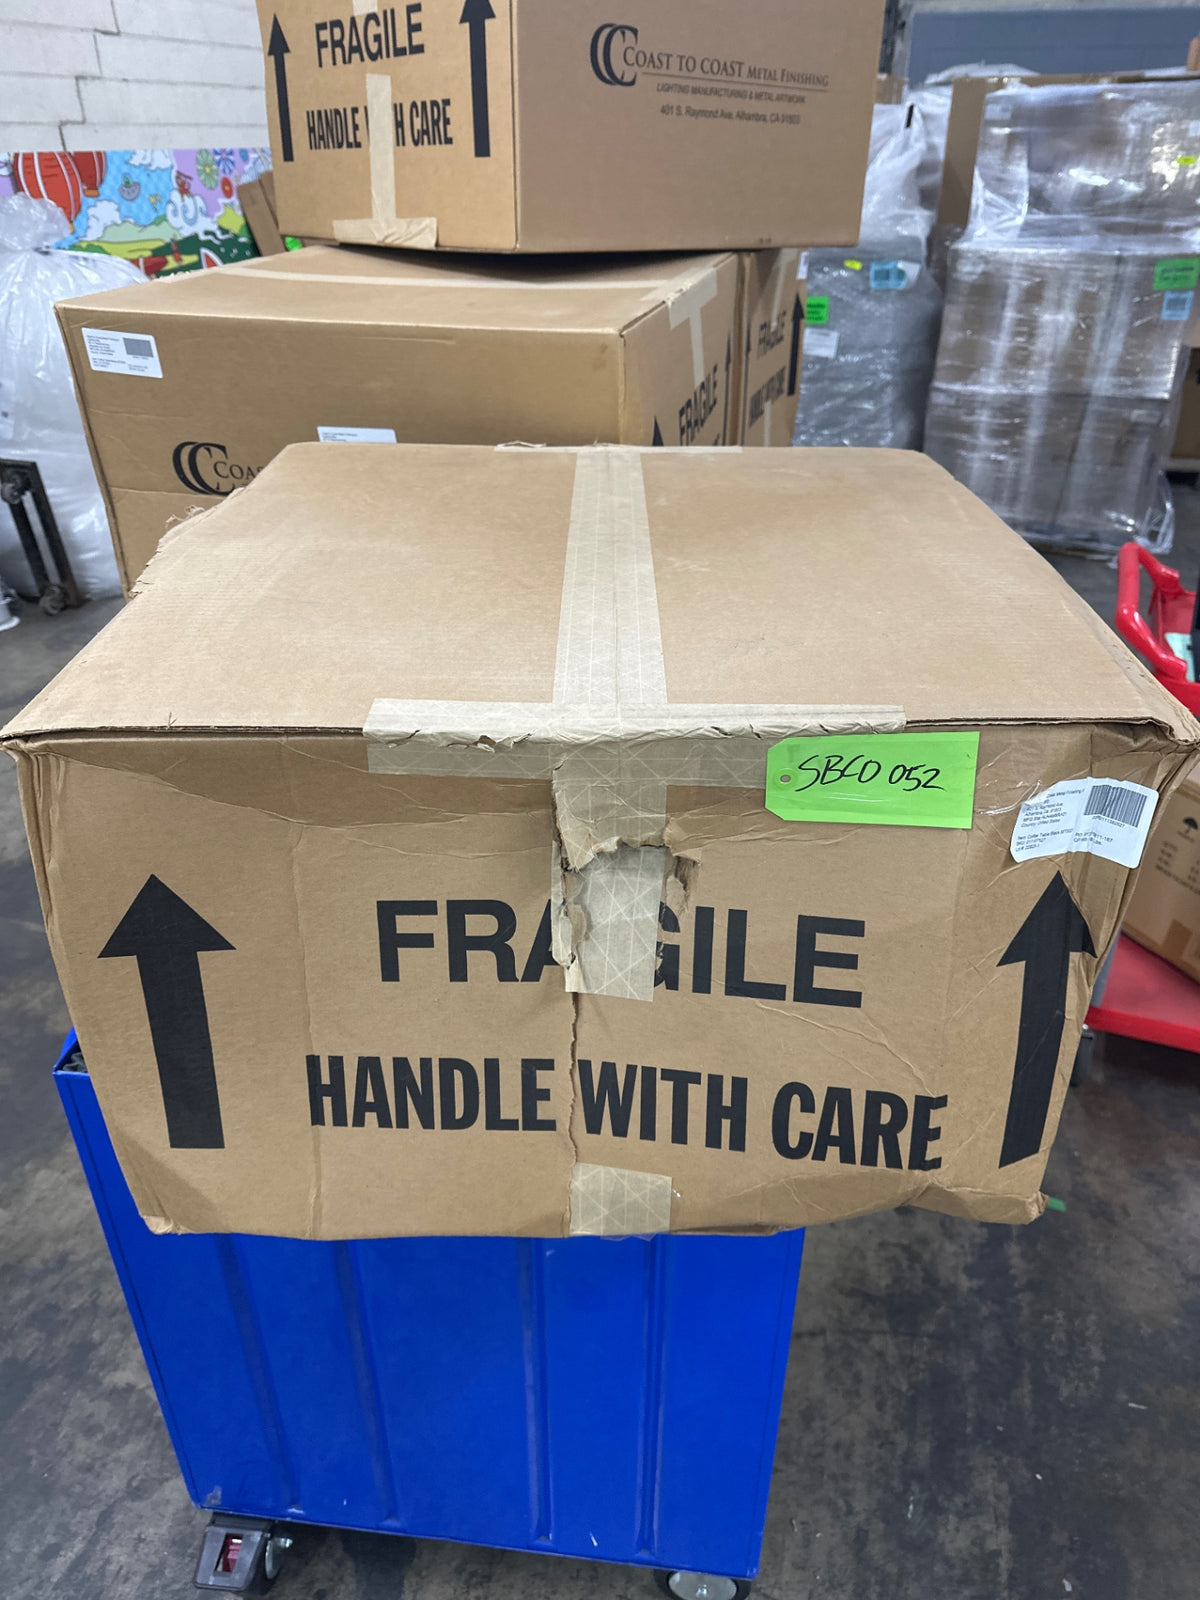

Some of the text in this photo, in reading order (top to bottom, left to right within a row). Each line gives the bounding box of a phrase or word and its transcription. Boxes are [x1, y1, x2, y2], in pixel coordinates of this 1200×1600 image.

[315, 3, 425, 68] FRAGILE
[677, 54, 696, 72] TO
[700, 57, 744, 77] COAST
[306, 107, 362, 150] HANDLE
[409, 98, 453, 147] CARE
[888, 764, 946, 791] 052
[306, 1054, 948, 1171] HANDLE WITH CARE
